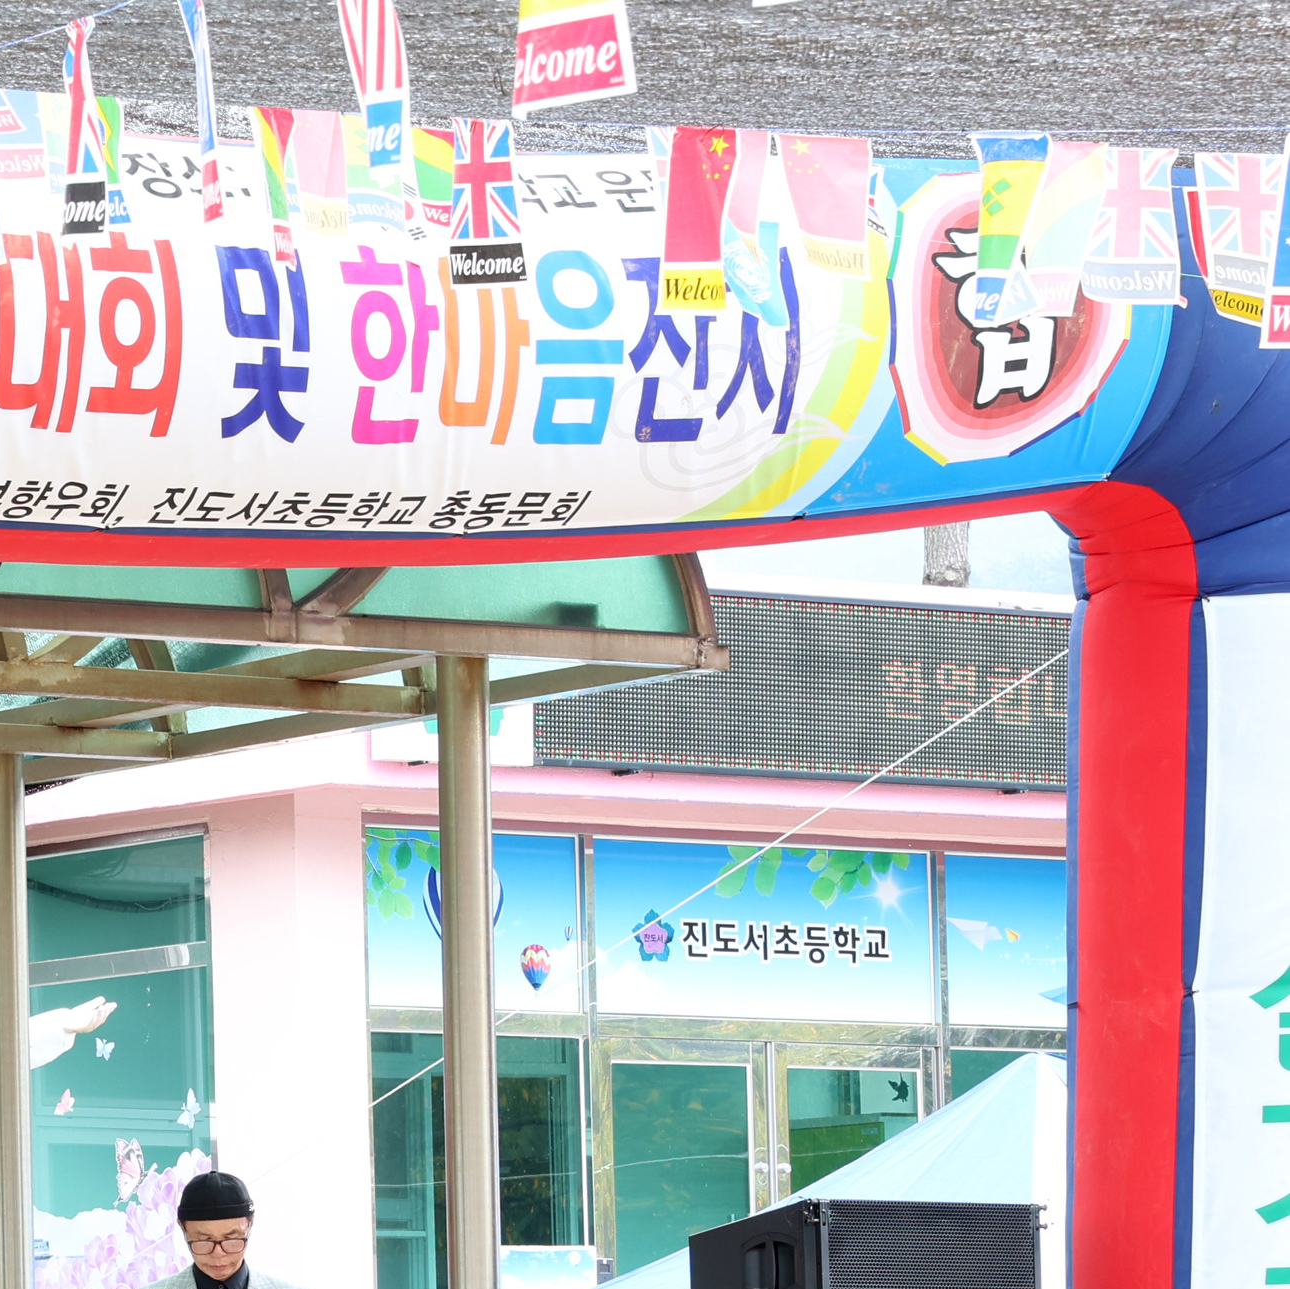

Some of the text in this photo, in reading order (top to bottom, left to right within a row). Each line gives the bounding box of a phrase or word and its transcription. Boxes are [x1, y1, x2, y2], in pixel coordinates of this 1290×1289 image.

[515, 39, 618, 89] elcome
[450, 252, 524, 277] Welcome
[664, 275, 725, 302] Welco
[215, 245, 311, 445] 및
[151, 484, 425, 534] 진도서초등학교
[426, 488, 592, 533] 총동문회
[680, 917, 891, 967] 진도서초등학교
